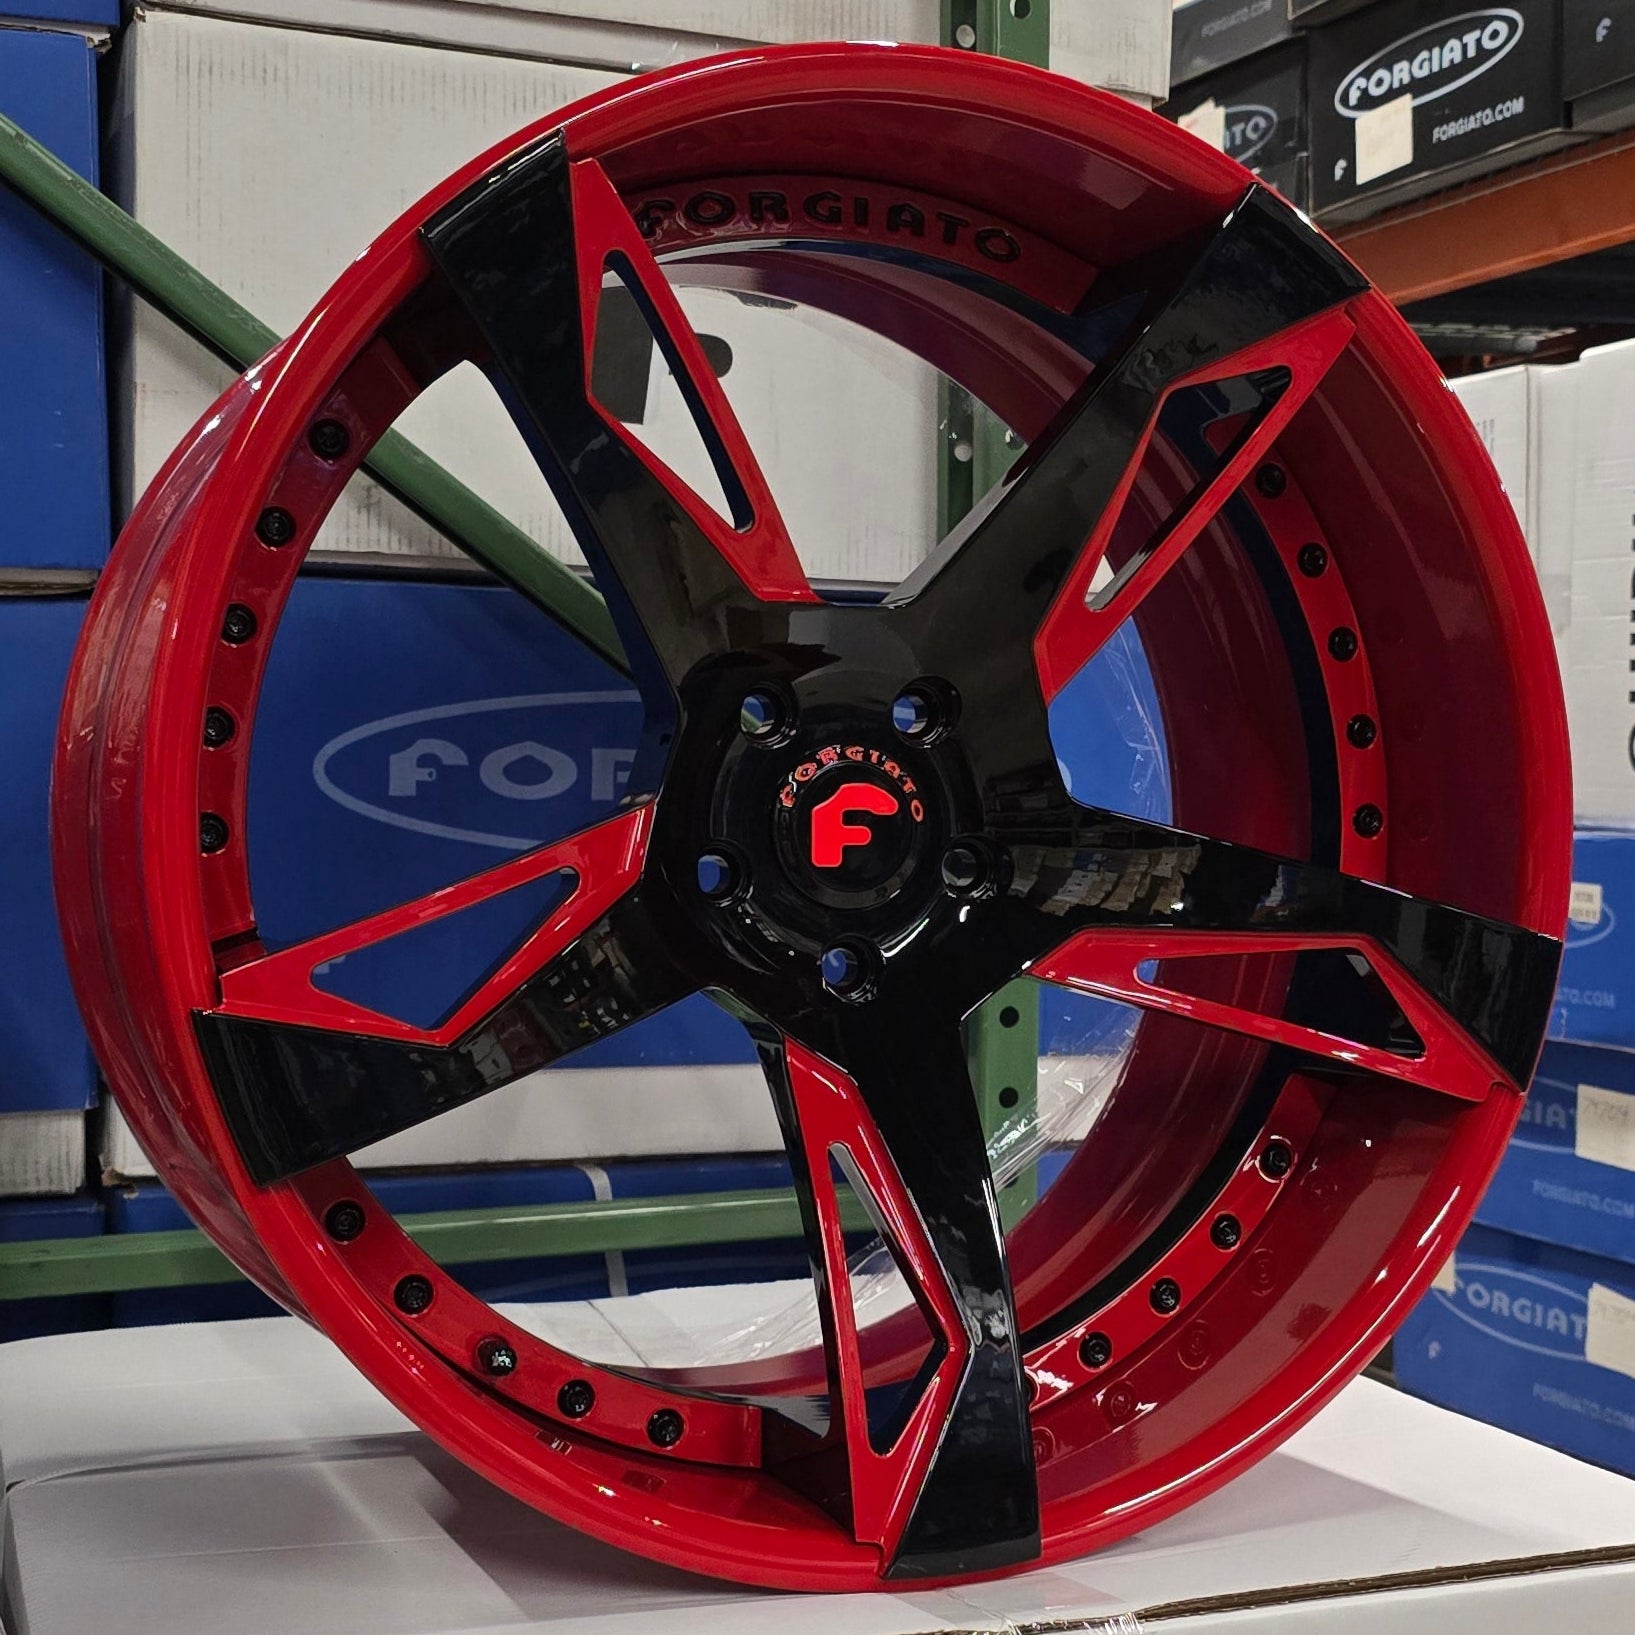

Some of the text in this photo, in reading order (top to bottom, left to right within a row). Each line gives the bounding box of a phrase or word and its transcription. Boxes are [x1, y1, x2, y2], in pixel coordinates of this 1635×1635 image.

[1348, 20, 1509, 106] FORGIATO
[1432, 96, 1524, 144] FORGIATO.COM
[1334, 159, 1347, 181] F
[633, 189, 1022, 264] FORGIATO
[779, 746, 924, 823] FORGIATO
[811, 783, 899, 867] F
